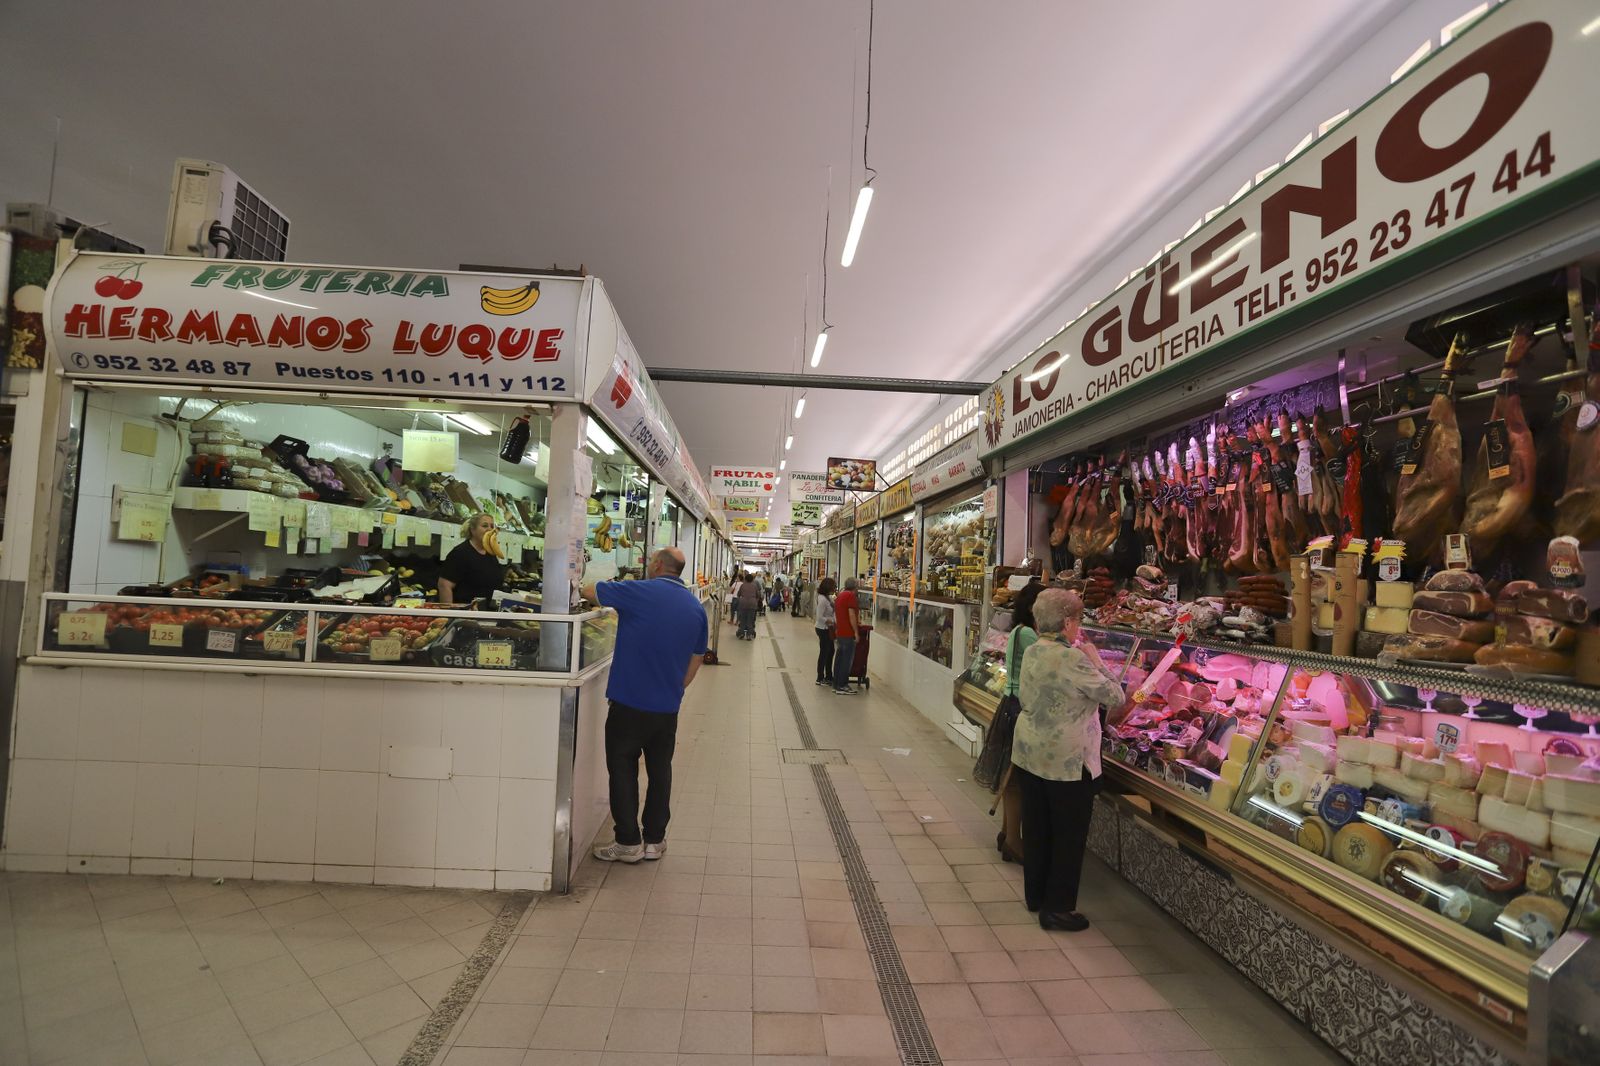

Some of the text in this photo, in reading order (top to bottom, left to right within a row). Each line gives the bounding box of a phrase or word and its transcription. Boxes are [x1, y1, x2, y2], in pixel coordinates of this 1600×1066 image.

[1013, 20, 1553, 416] LO GÜENO
[190, 264, 450, 297] FRUTERIA
[1012, 393, 1075, 439] JAMONERIA
[1085, 313, 1225, 402] CHARCUTERIA
[1233, 270, 1297, 327] TELF.
[1305, 238, 1358, 293] 952
[1369, 208, 1412, 262] 23
[1424, 171, 1476, 229] 47
[1492, 130, 1556, 194] 44
[63, 303, 565, 365] HERMANOS LUQUE
[93, 355, 142, 371] 952
[147, 356, 180, 373] 32
[186, 359, 216, 375] 48
[223, 360, 252, 377] 87
[274, 361, 375, 382] Puestos
[382, 367, 425, 385] 110
[448, 372, 491, 388] 111
[500, 376, 514, 392] y
[522, 375, 567, 392] 112
[636, 425, 653, 448] 952
[713, 469, 774, 479] FRUTAS
[724, 479, 761, 488] NABIL
[805, 493, 843, 502] CONFITERIA
